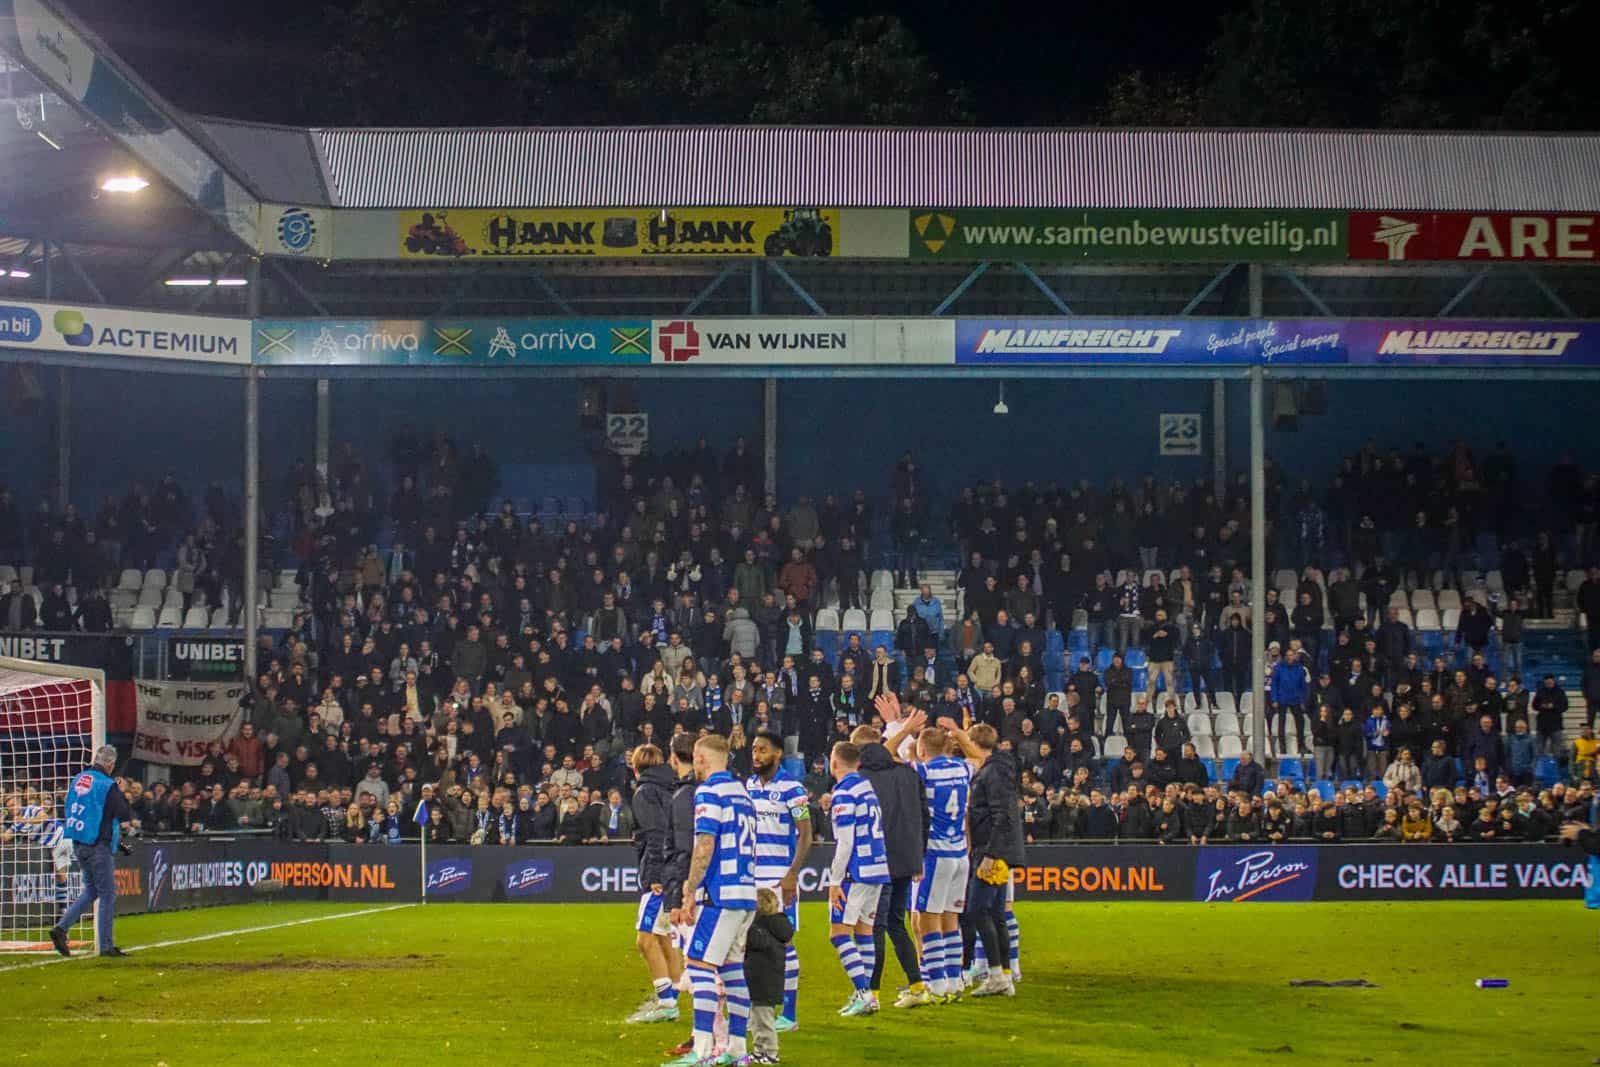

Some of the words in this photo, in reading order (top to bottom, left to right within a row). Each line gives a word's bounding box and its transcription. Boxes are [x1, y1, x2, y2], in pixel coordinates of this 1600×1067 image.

[489, 215, 595, 249] HAANK
[649, 215, 756, 249] HAANK
[963, 221, 1338, 252] www.samenbewustveilig.nl
[99, 327, 237, 354] ACTEMIUM
[344, 331, 419, 352] arriva
[521, 330, 596, 351] arriva
[707, 332, 751, 350] VAN
[760, 332, 847, 350] WIJNEN
[976, 329, 1181, 354] MAINFREIGHT
[1377, 330, 1580, 355] MAINFREIGHT
[609, 416, 645, 438] 22
[1164, 416, 1198, 439] 23
[945, 789, 960, 820] 4
[246, 861, 268, 886] OP
[270, 862, 395, 888] INPERSON.NL
[581, 867, 642, 892] CHE
[1012, 866, 1164, 892] PERSON.NL
[1204, 869, 1234, 902] In
[1235, 851, 1309, 889] Person
[1338, 864, 1433, 889] CHECK
[1440, 864, 1508, 888] ALLE
